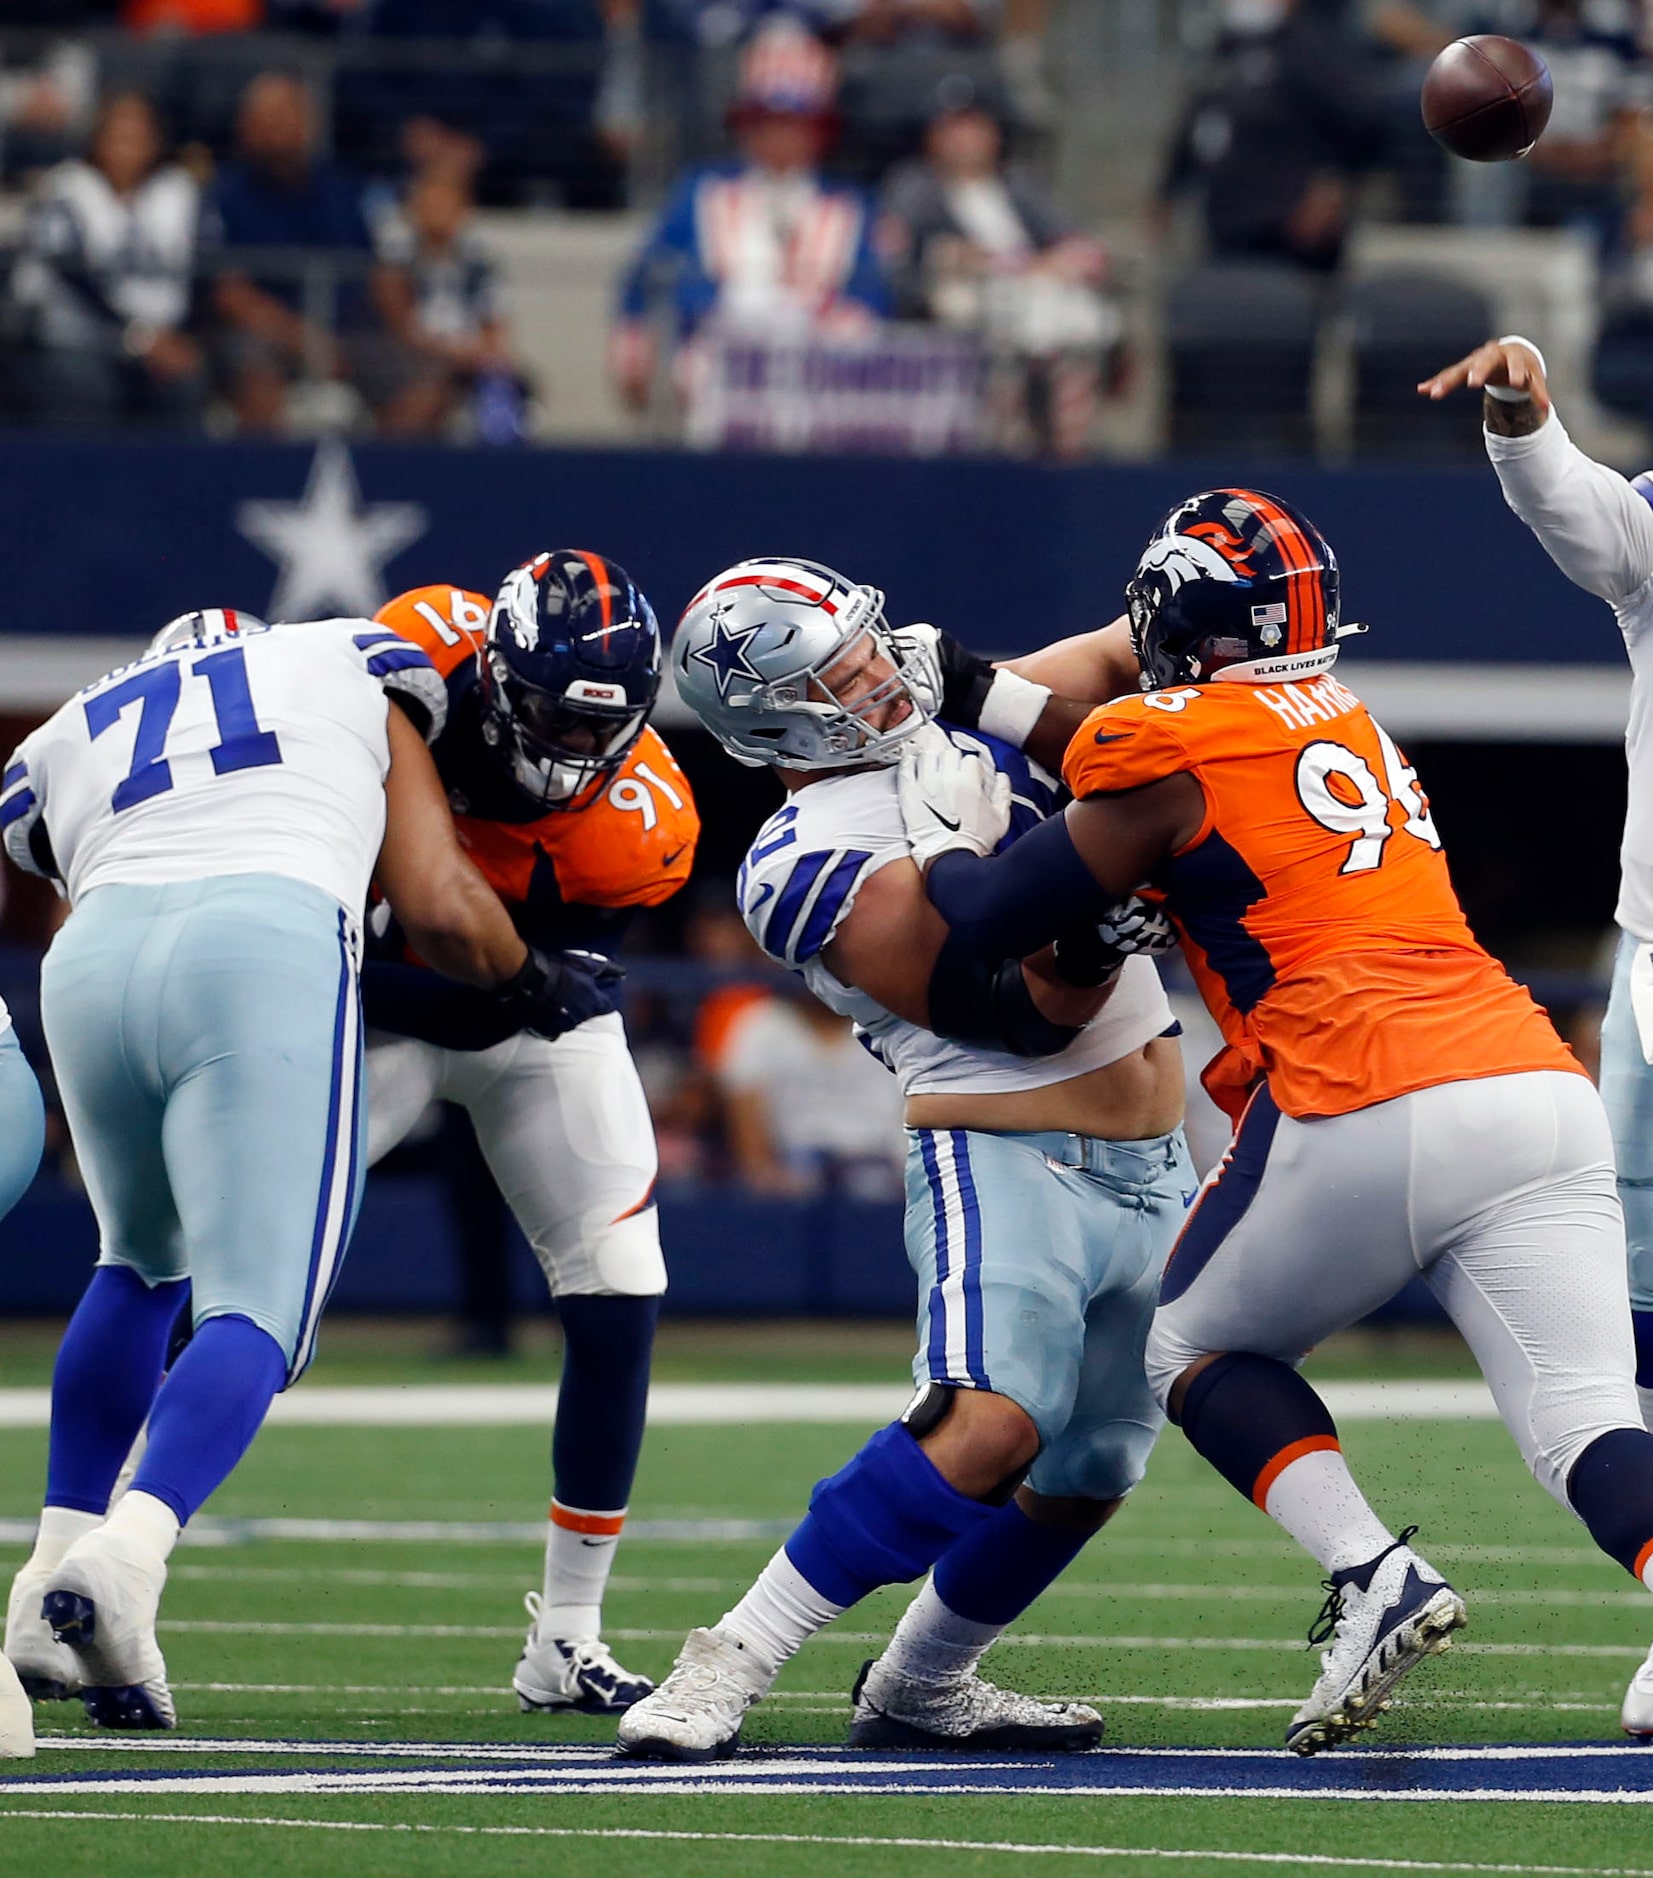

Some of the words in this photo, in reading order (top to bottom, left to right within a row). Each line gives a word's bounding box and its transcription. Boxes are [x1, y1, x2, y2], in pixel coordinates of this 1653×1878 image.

[1254, 663, 1289, 675] BLACK
[1290, 659, 1316, 671] LIVES
[84, 647, 284, 814] 71
[608, 761, 684, 832] 91
[1293, 738, 1443, 877] 96
